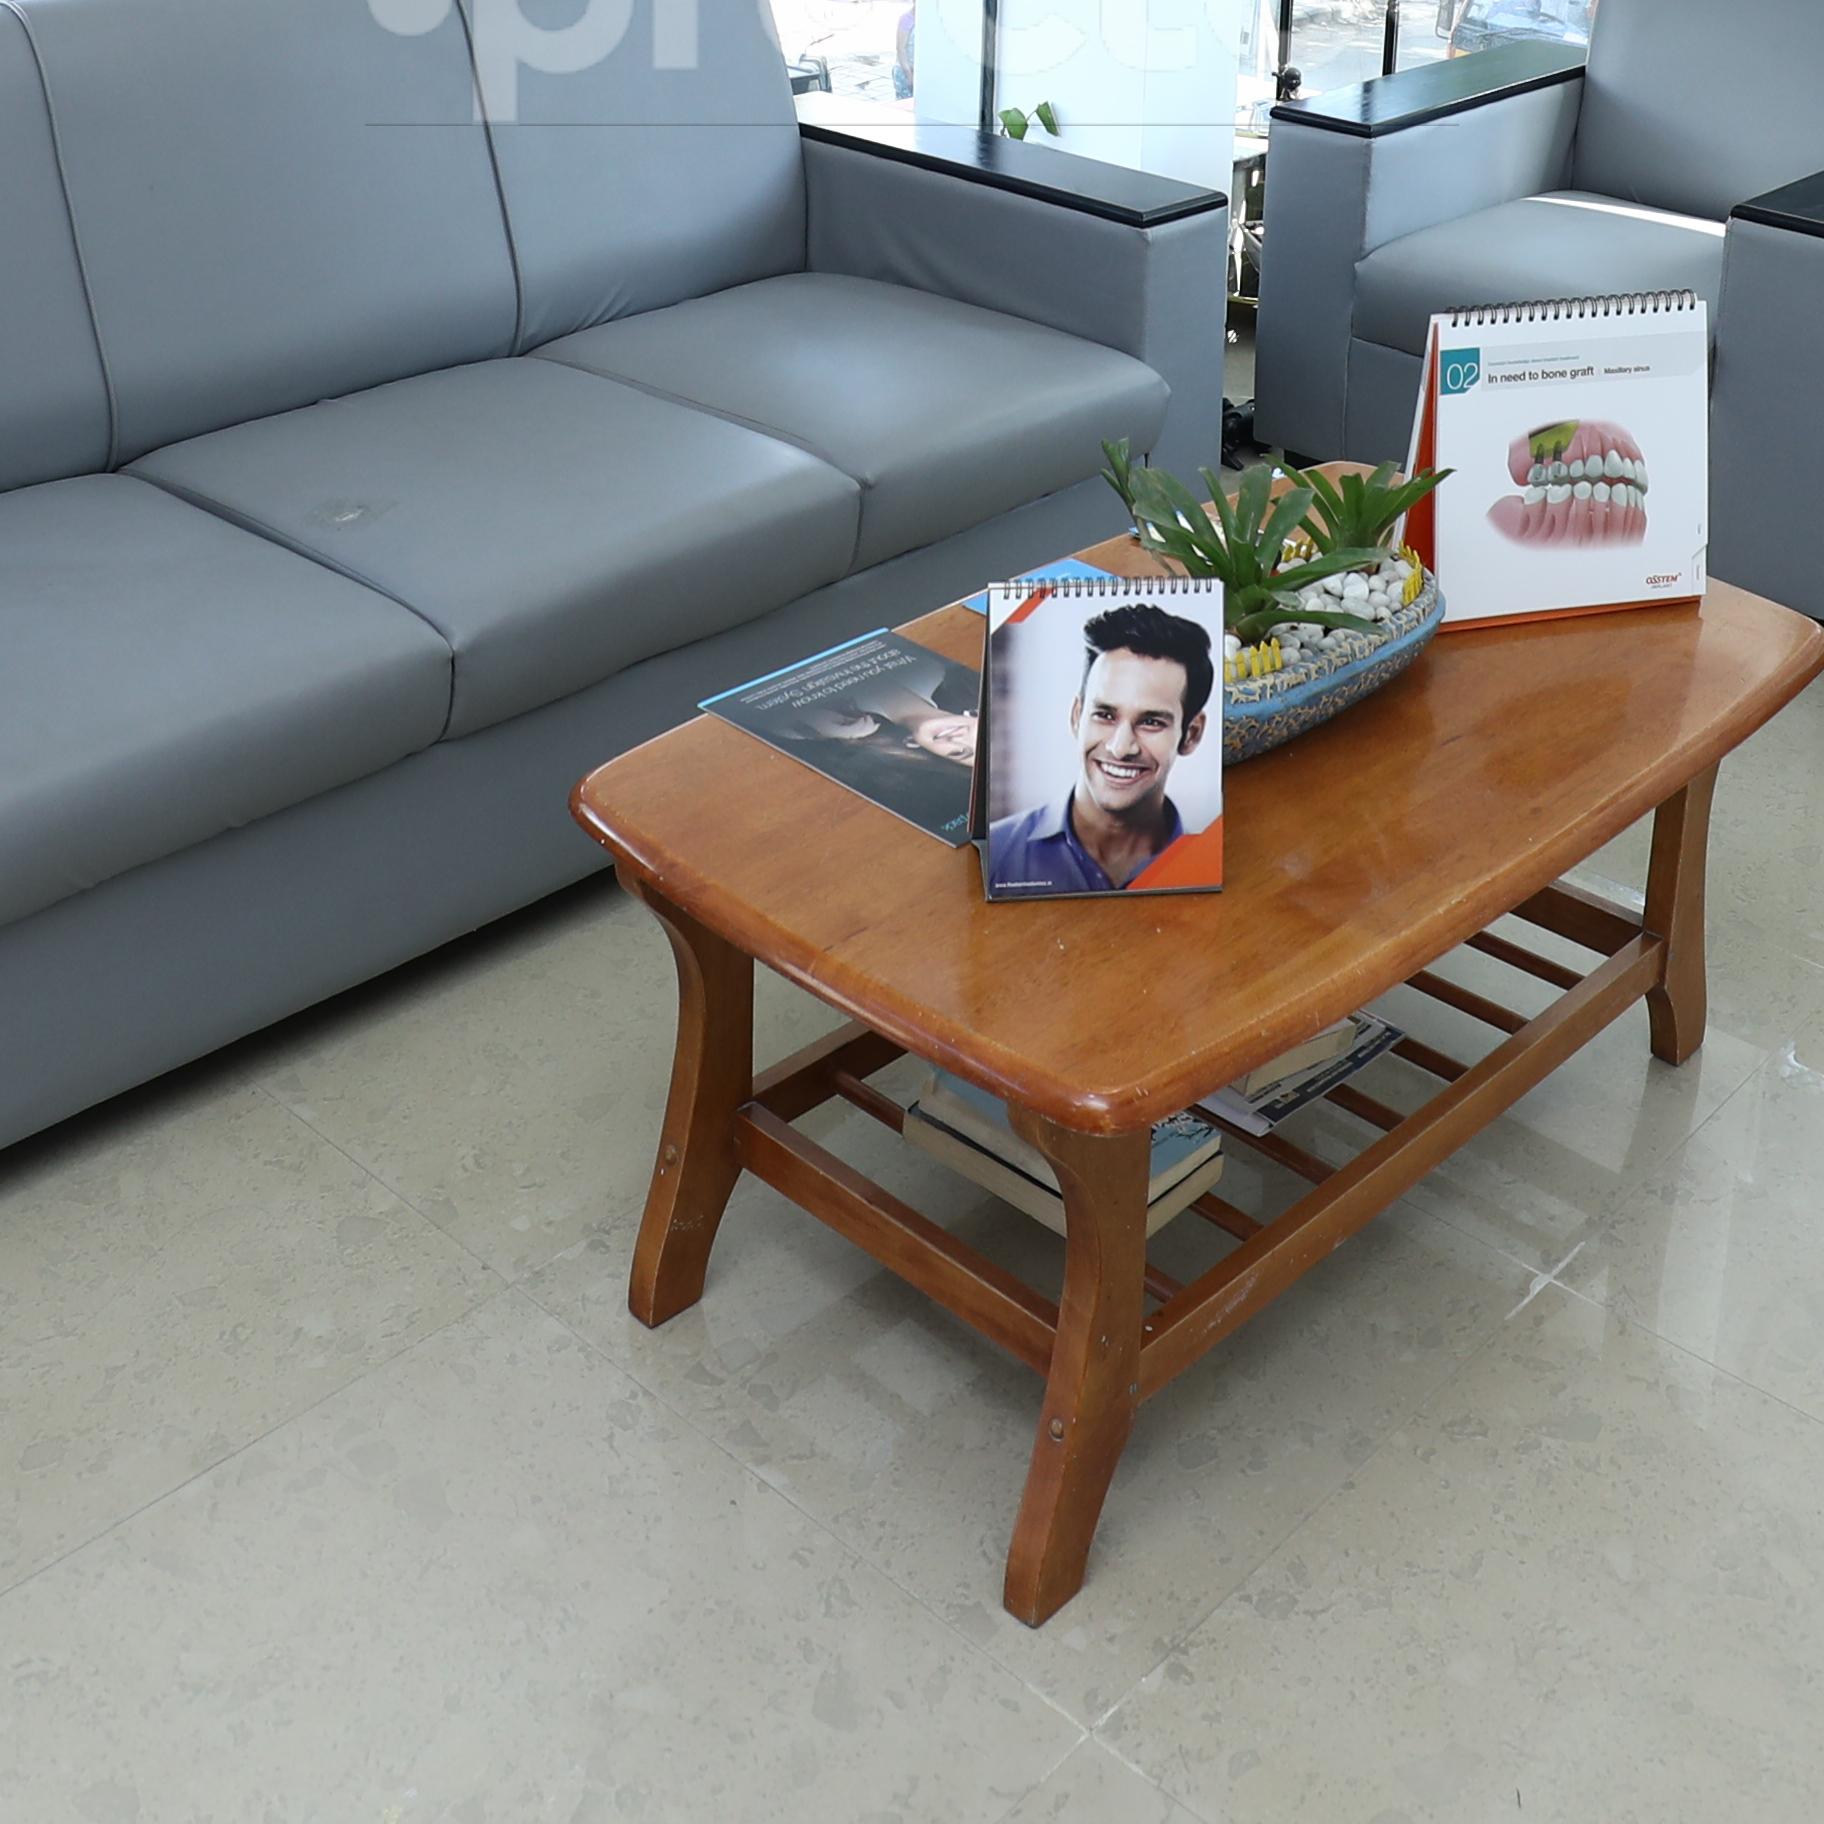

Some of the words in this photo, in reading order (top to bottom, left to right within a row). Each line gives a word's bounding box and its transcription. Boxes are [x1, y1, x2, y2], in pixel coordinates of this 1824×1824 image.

[1447, 362, 1478, 389] 02
[1488, 373, 1498, 384] In
[1500, 370, 1526, 383] need
[1528, 370, 1539, 381] to
[1541, 368, 1567, 380] bone
[1570, 365, 1595, 380] graft
